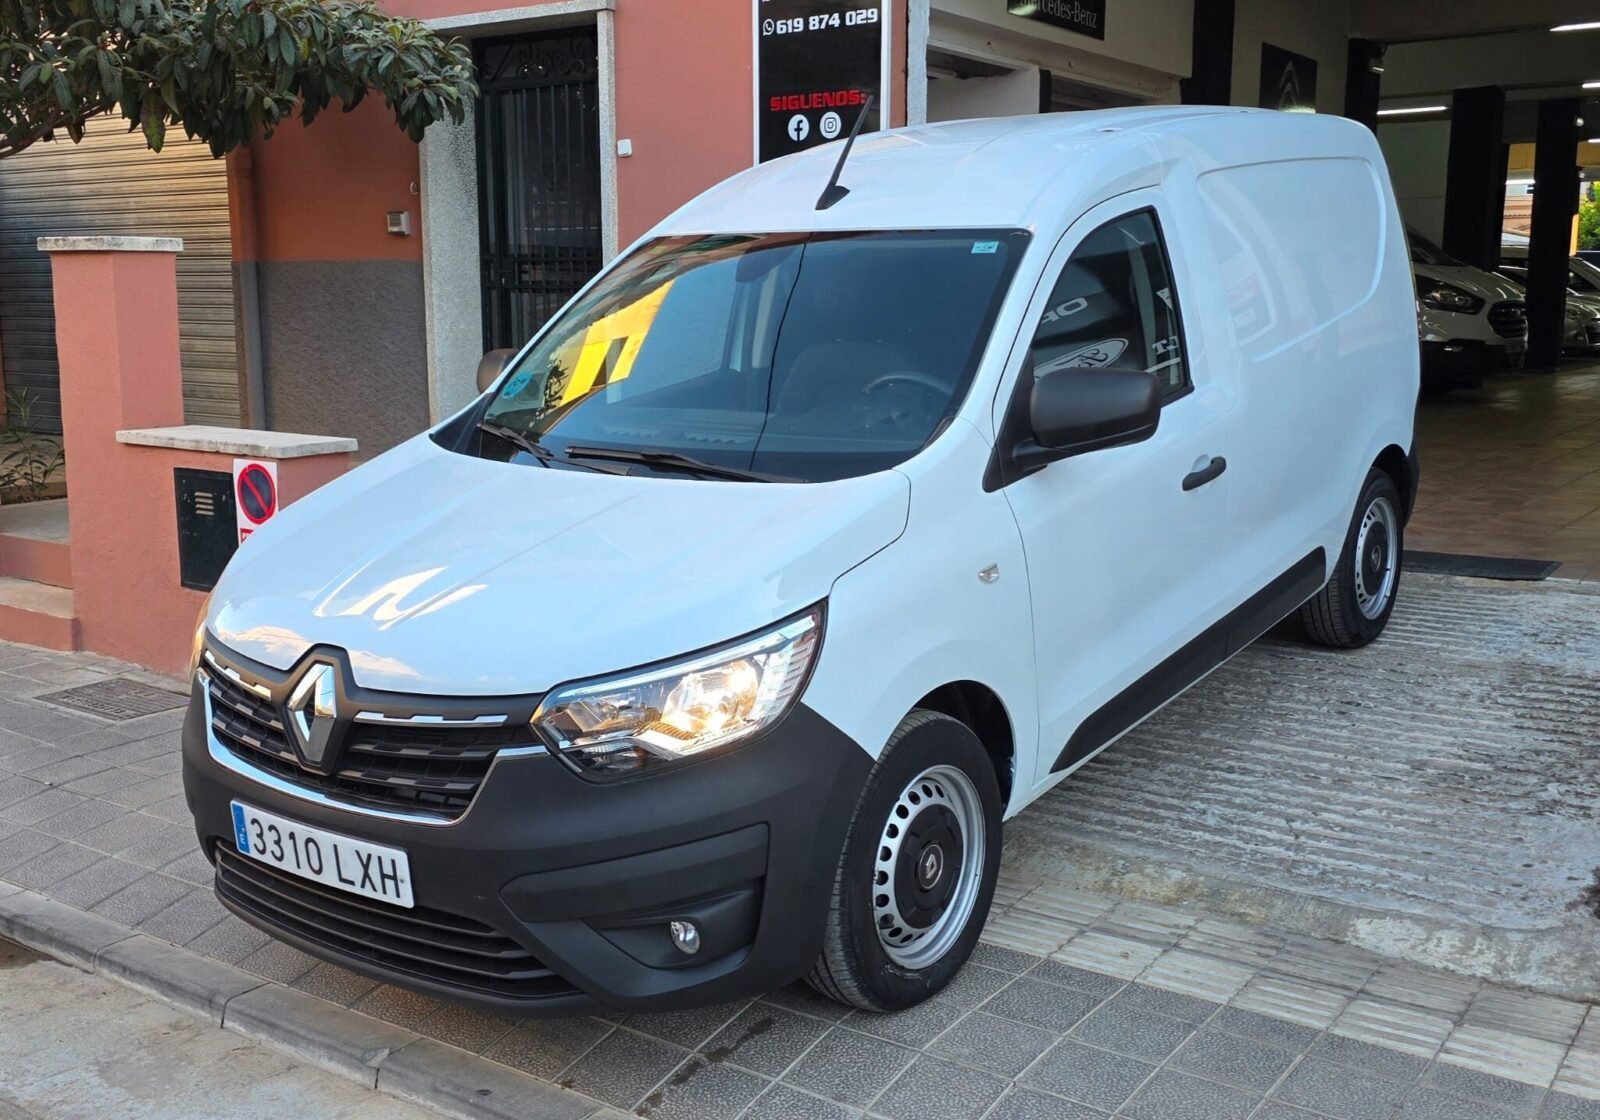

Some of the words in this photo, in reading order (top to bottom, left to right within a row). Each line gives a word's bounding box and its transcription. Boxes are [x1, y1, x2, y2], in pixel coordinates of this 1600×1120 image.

[776, 18, 804, 35] 619
[808, 13, 841, 30] 874
[845, 8, 878, 26] 029
[250, 818, 324, 876] 3310
[333, 843, 401, 899] LXH
